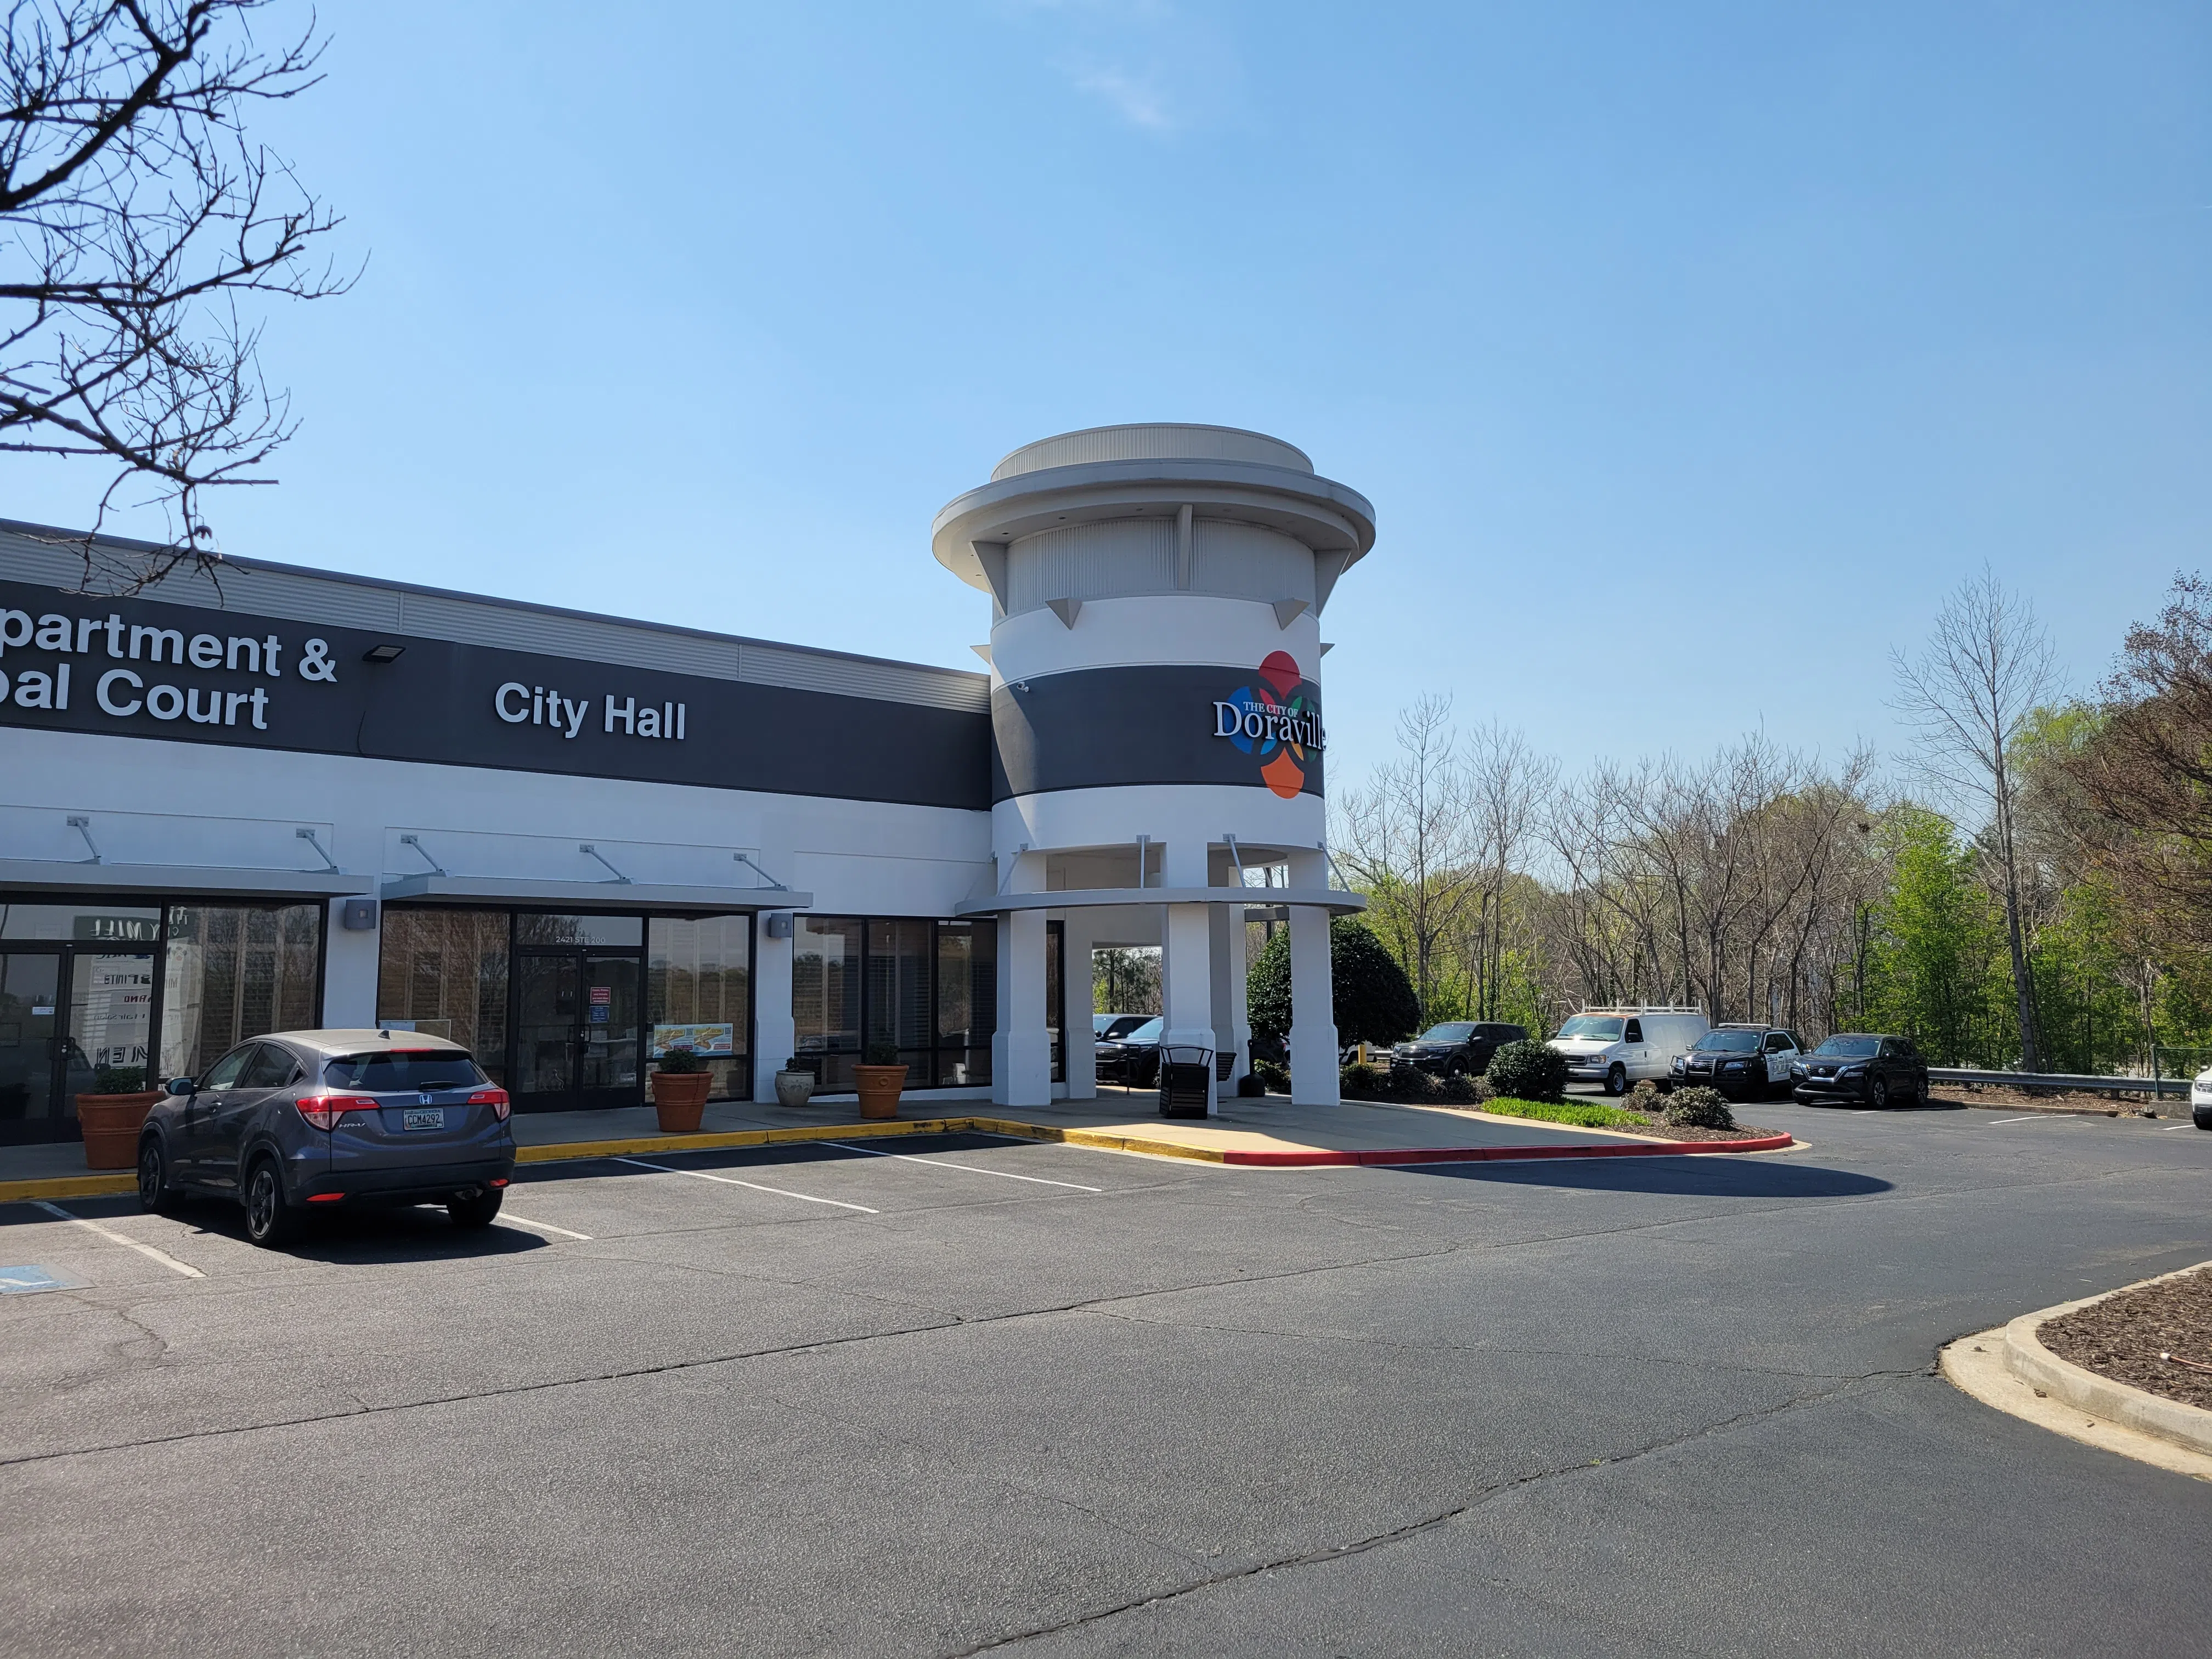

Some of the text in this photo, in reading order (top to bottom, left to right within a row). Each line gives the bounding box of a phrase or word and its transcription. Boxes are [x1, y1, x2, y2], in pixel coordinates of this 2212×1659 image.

[0, 607, 338, 682] partment &
[0, 663, 269, 730] al Court
[495, 682, 685, 740] City Hall
[1243, 702, 1298, 718] THE CITY OF
[1212, 701, 1327, 751] Doraville
[408, 1114, 441, 1125] CCM4292
